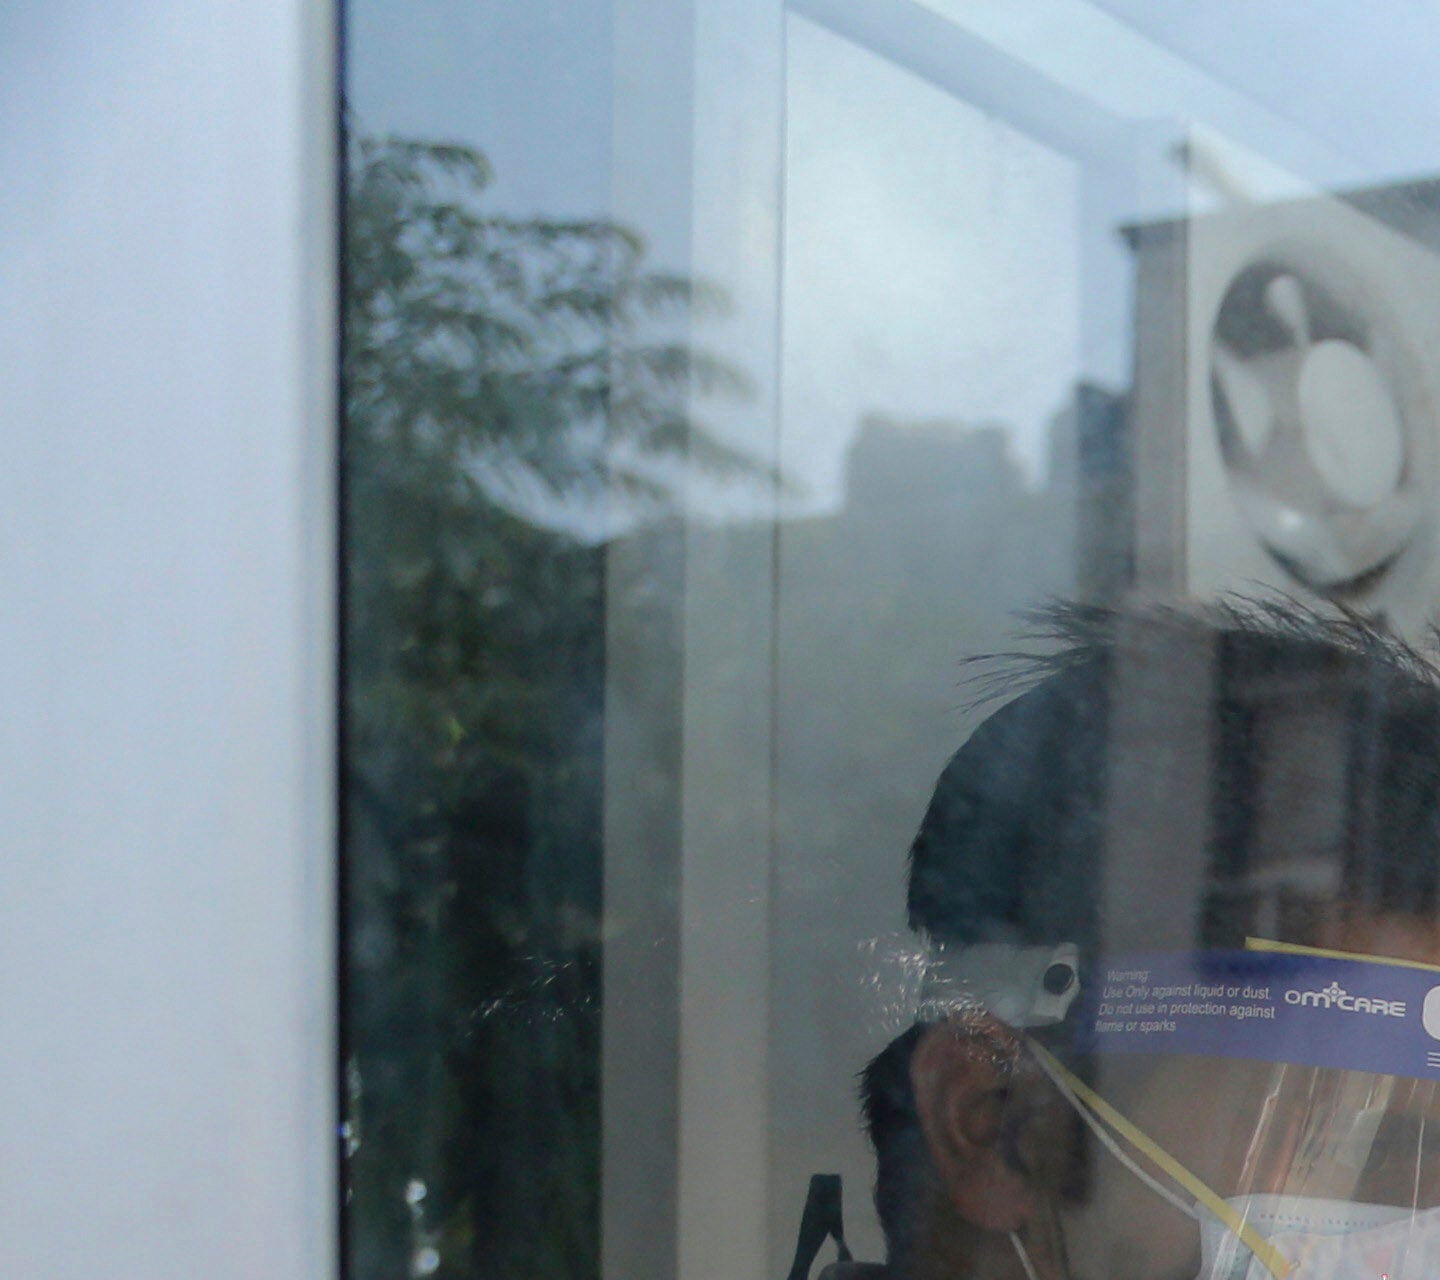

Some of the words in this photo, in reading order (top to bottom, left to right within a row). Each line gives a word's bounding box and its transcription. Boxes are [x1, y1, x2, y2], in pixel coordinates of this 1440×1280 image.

[1103, 987, 1122, 999] Use
[1152, 984, 1192, 1000] against
[1193, 983, 1225, 999] liquid
[1227, 987, 1240, 998] or
[1098, 1003, 1114, 1016] Do
[1115, 1003, 1133, 1014] not
[1136, 1005, 1155, 1015] use
[1158, 1003, 1168, 1014] in
[1169, 1002, 1226, 1016] protection
[1229, 1004, 1276, 1020] against
[1125, 1021, 1137, 1032] or
[1140, 1019, 1176, 1035] sparks
